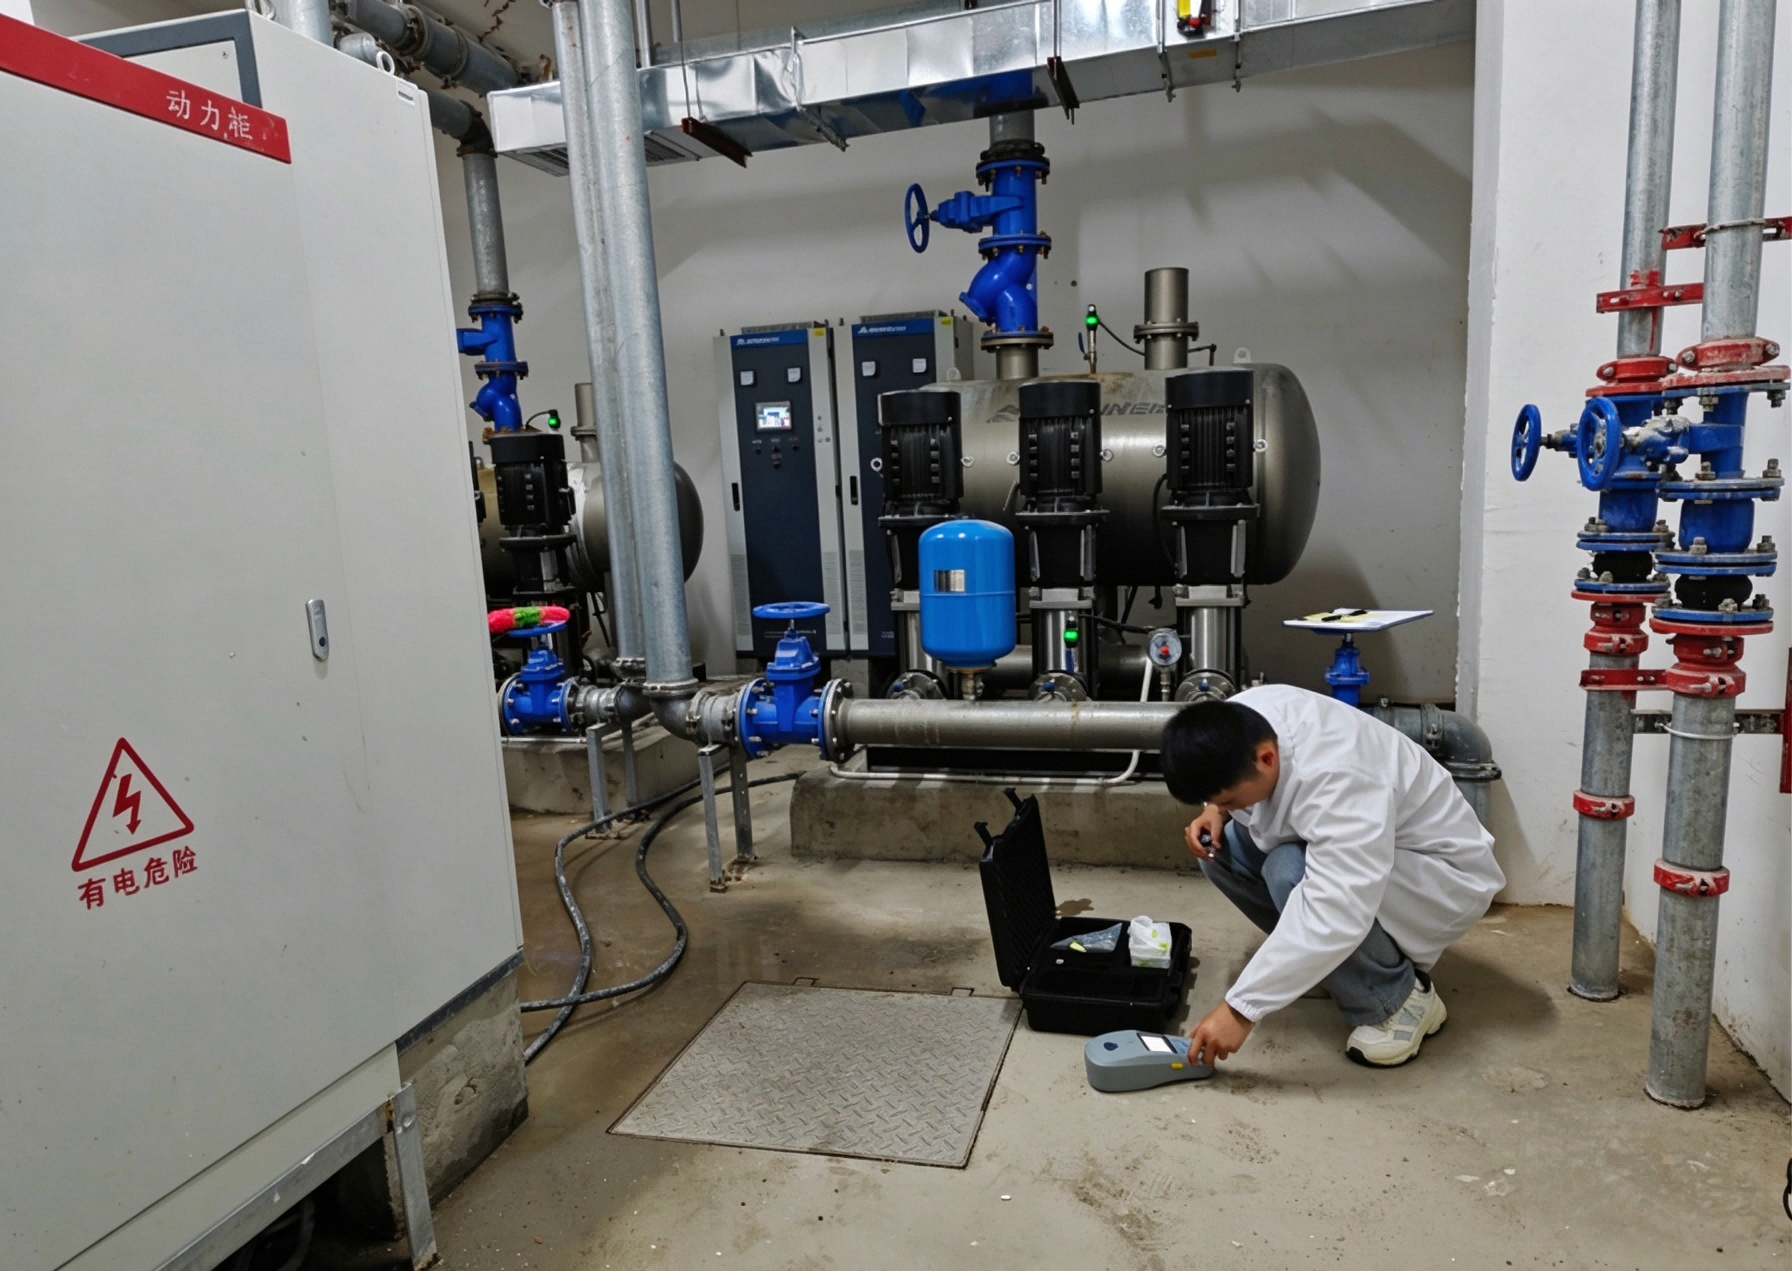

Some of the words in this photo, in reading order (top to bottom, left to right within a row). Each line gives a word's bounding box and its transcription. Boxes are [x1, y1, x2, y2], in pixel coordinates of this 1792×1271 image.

[166, 89, 253, 140] 动力柜
[77, 845, 198, 911] 有电危险
